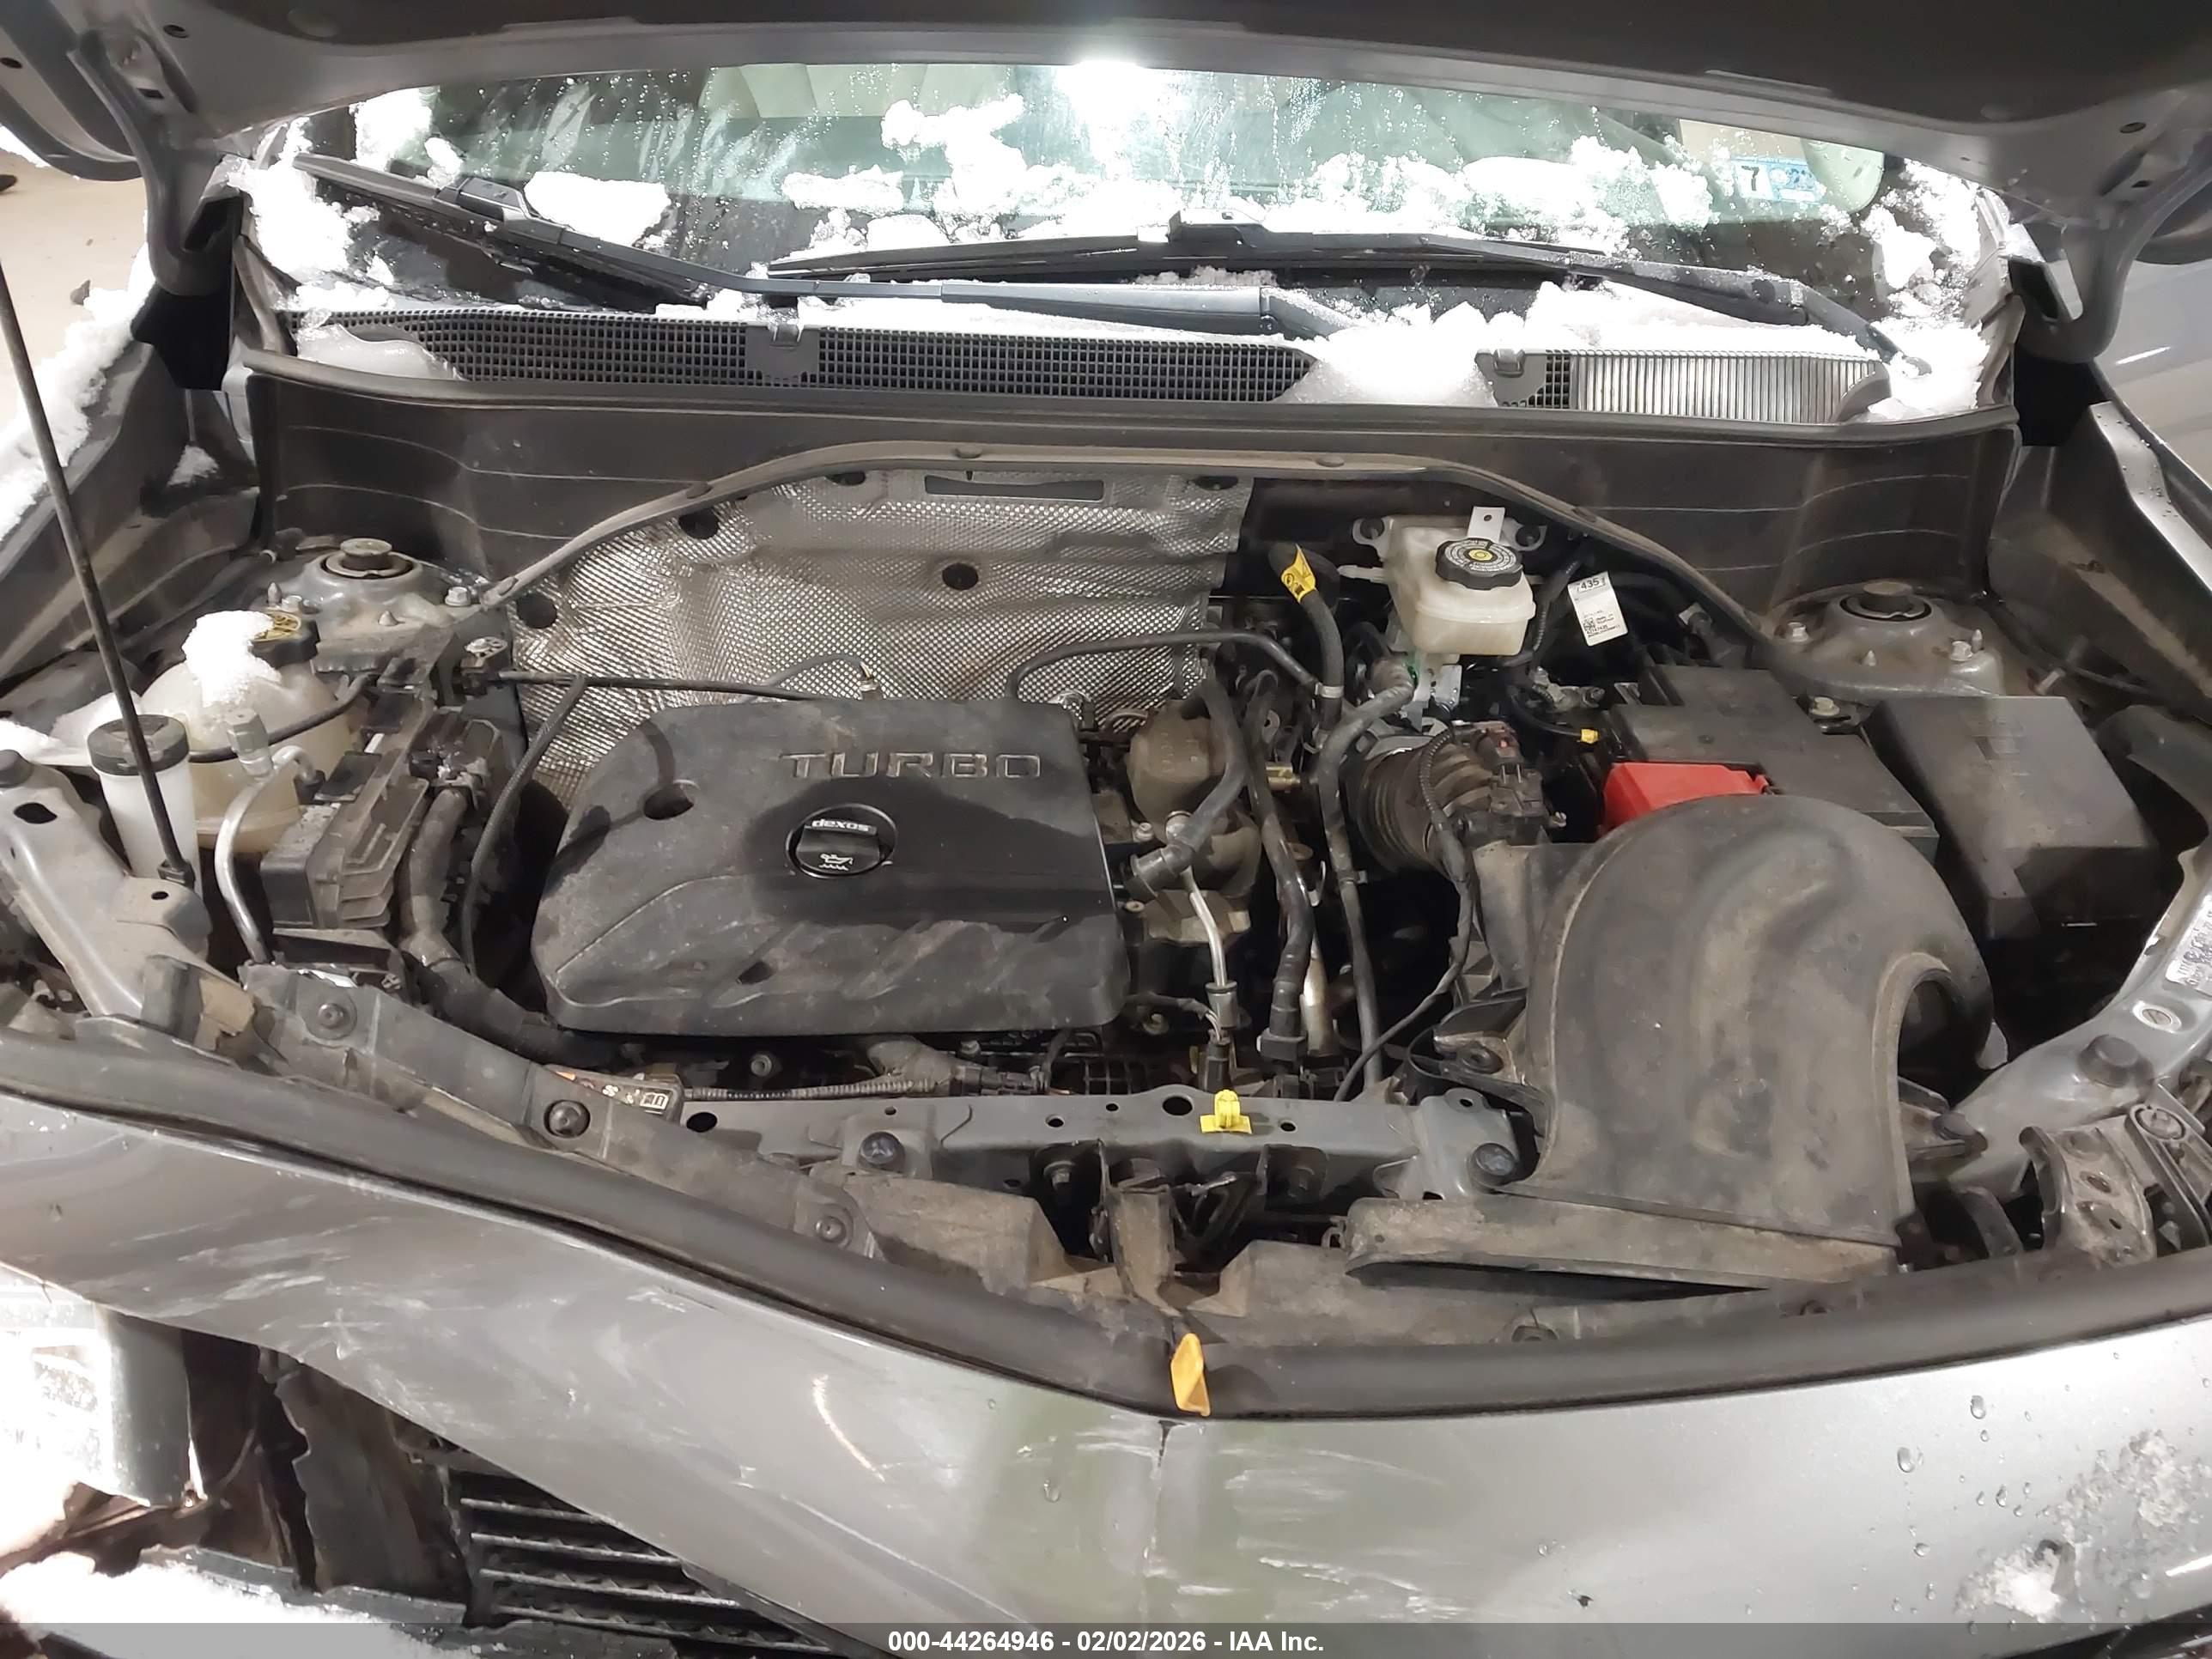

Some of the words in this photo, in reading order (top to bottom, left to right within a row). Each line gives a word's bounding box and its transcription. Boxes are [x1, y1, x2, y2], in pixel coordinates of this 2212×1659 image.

[1741, 165, 1759, 191] 7
[1580, 577, 1600, 590] 435
[781, 752, 1041, 778] TURBO
[811, 817, 870, 833] dexos
